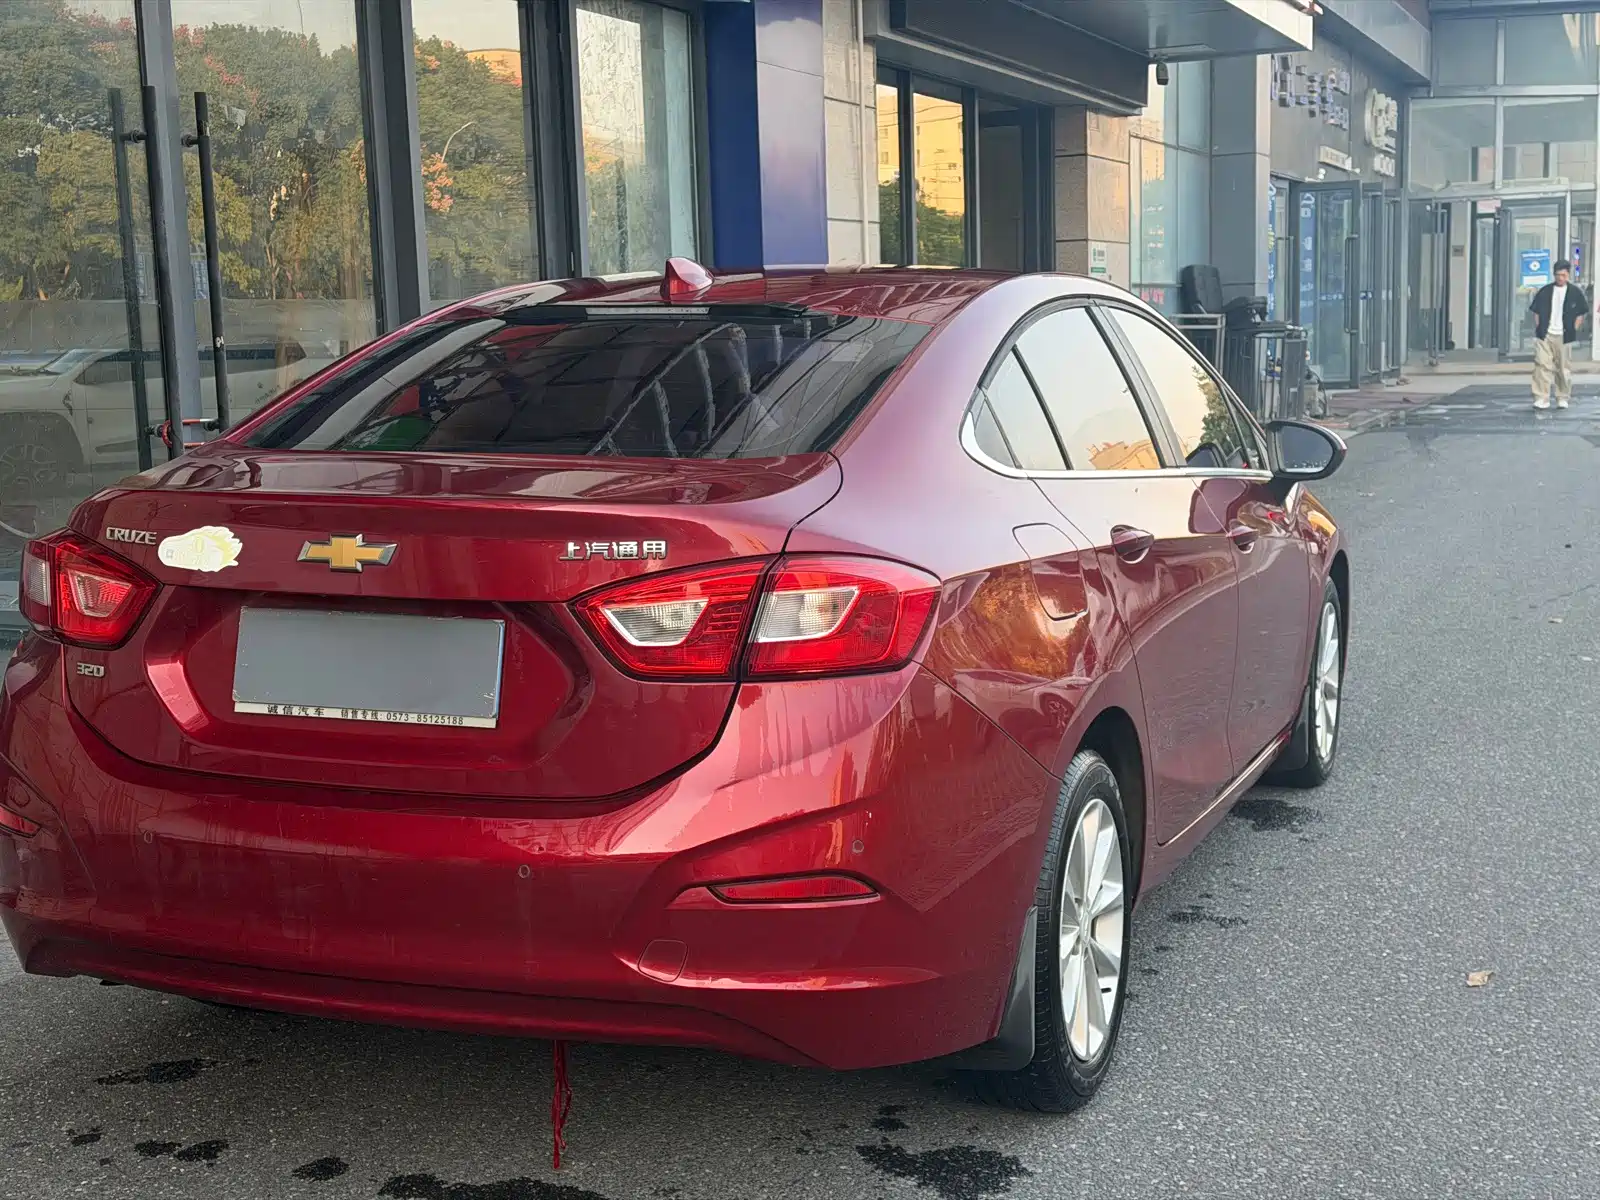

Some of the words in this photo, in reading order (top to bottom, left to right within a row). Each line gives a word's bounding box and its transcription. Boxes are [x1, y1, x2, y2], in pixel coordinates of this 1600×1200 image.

[106, 526, 157, 545] CRUZE
[559, 540, 667, 560] 上汽通用
[77, 662, 104, 677] 320
[267, 704, 325, 716] 诚信汽车
